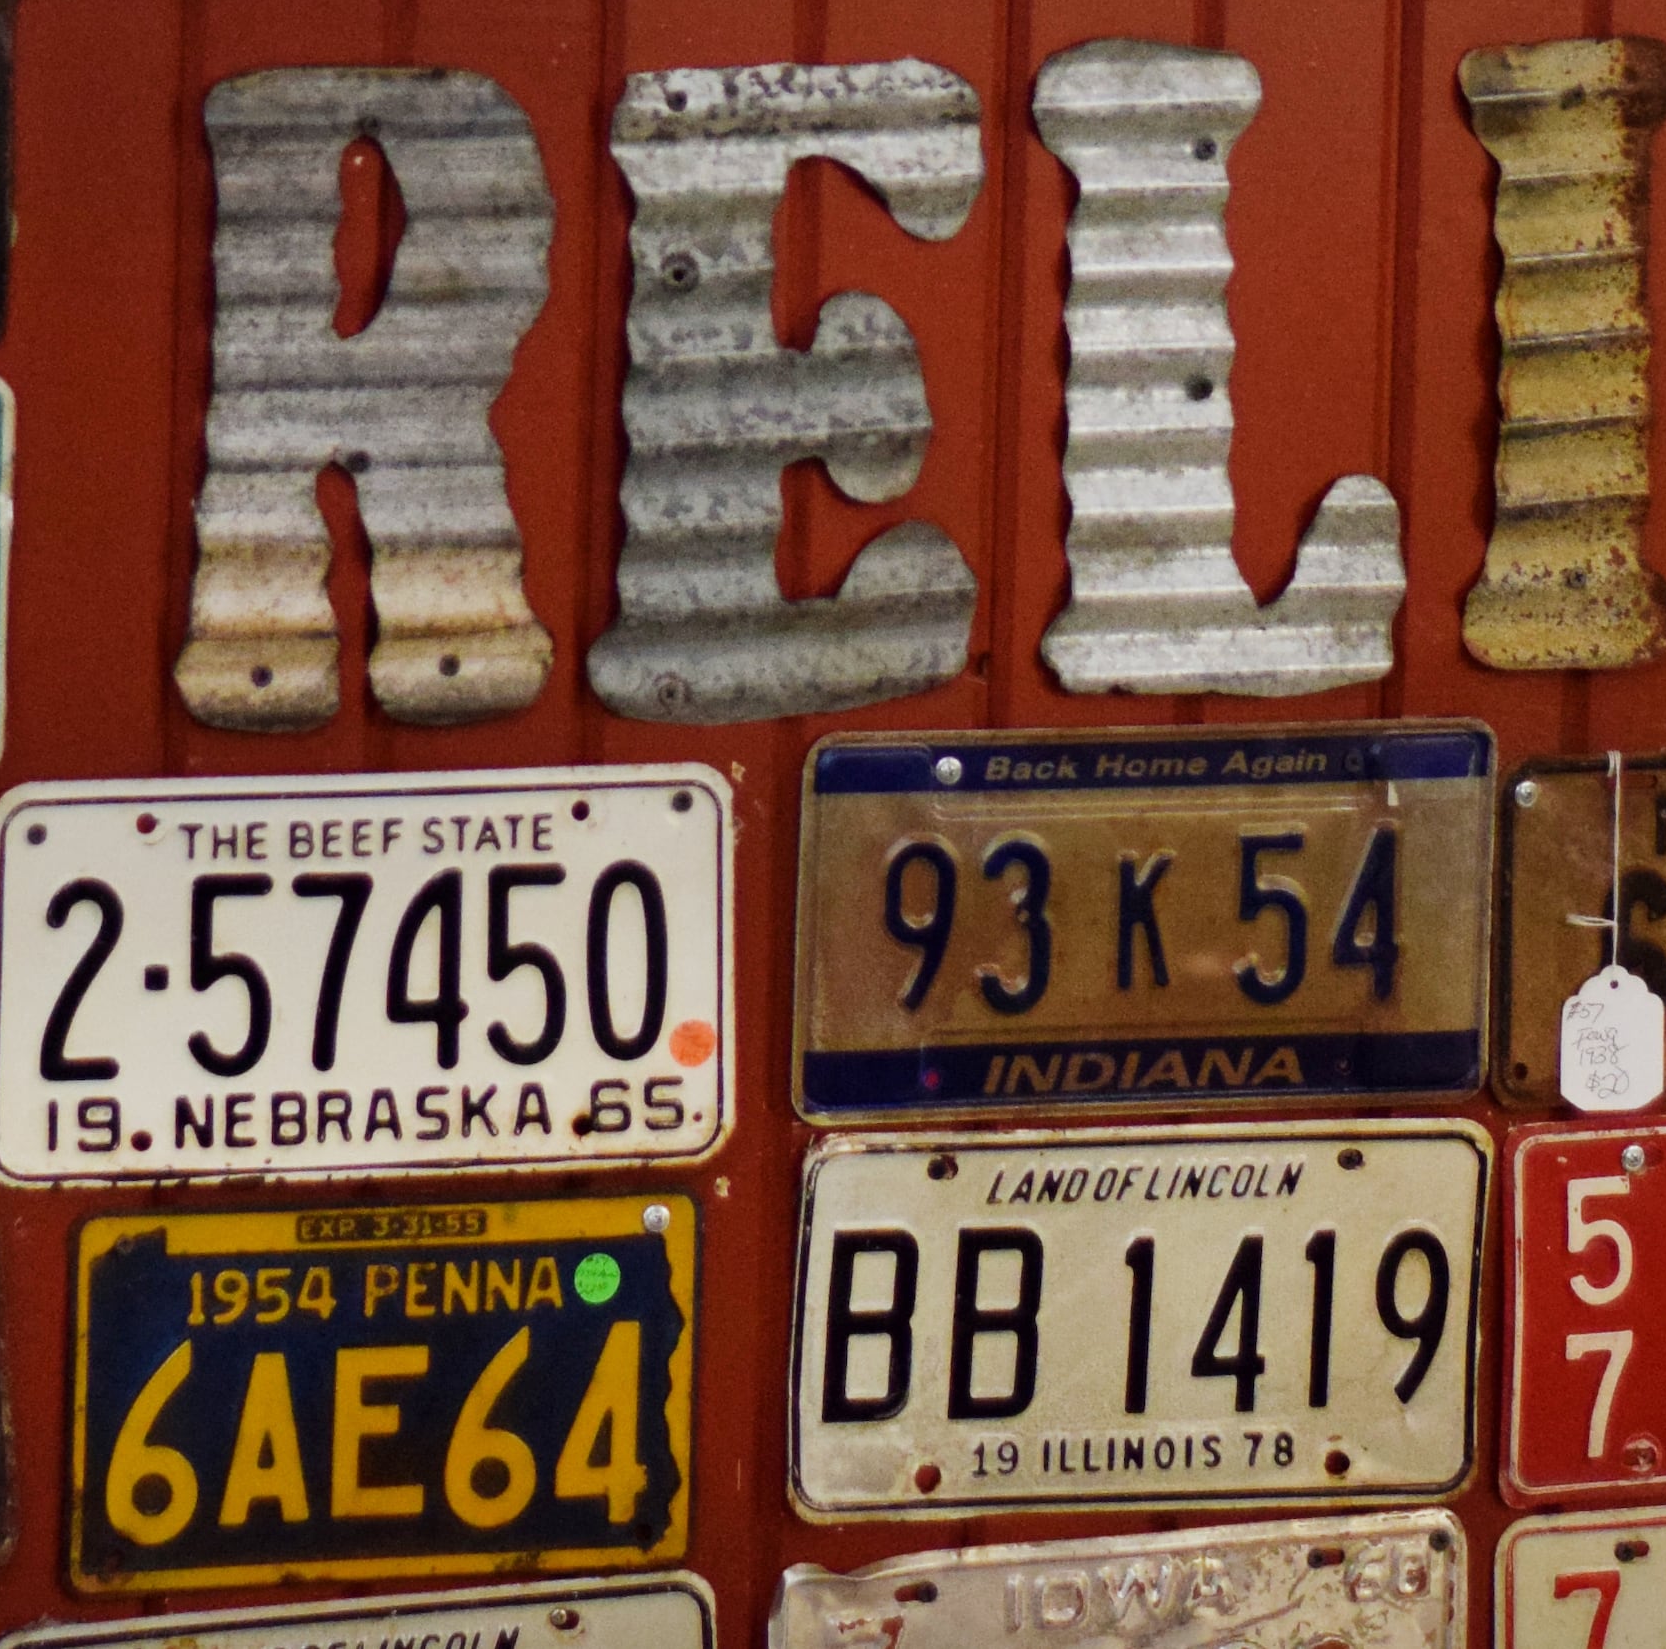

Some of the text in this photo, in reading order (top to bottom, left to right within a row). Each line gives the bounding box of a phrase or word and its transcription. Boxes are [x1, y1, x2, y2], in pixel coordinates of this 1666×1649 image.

[985, 749, 1327, 782] Back Home Again
[179, 811, 555, 861] THE BEEF STATE
[884, 821, 1401, 1016] 93 K 54
[984, 1047, 1305, 1095] INDIANA
[47, 1076, 686, 1152] 19 NEBRASKA 65
[188, 1255, 565, 1325] 1954 PENNA
[822, 1226, 1451, 1422] BB 1419
[105, 1321, 647, 1546] 6AE64
[972, 1431, 1295, 1477] 19 ILLINOIS 78
